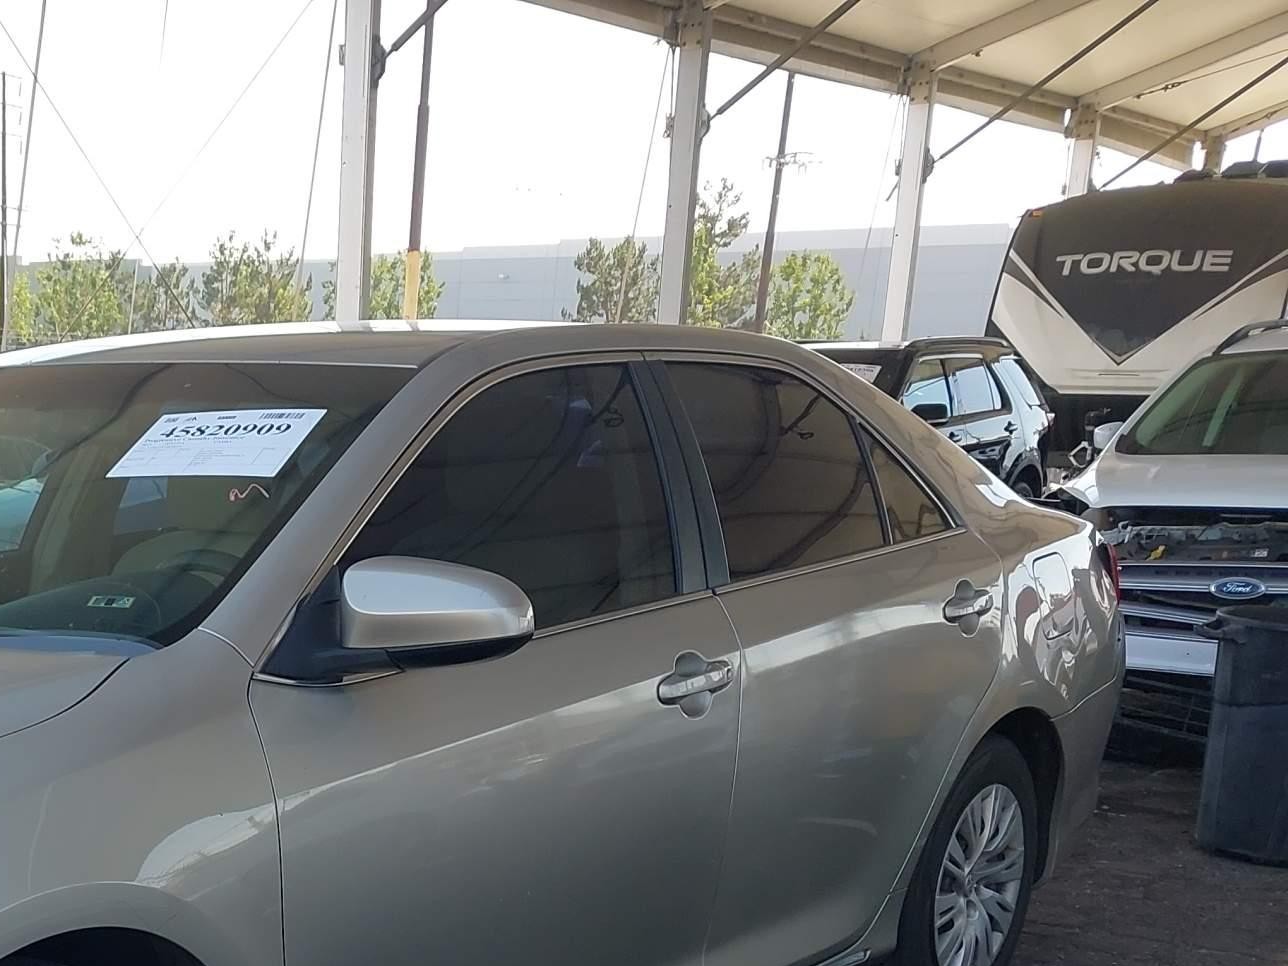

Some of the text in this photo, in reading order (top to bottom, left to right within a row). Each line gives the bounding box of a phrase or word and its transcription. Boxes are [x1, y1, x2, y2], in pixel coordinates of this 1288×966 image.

[1056, 249, 1233, 276] TORQUE
[160, 421, 292, 439] 45820909
[1223, 582, 1253, 593] Ford
